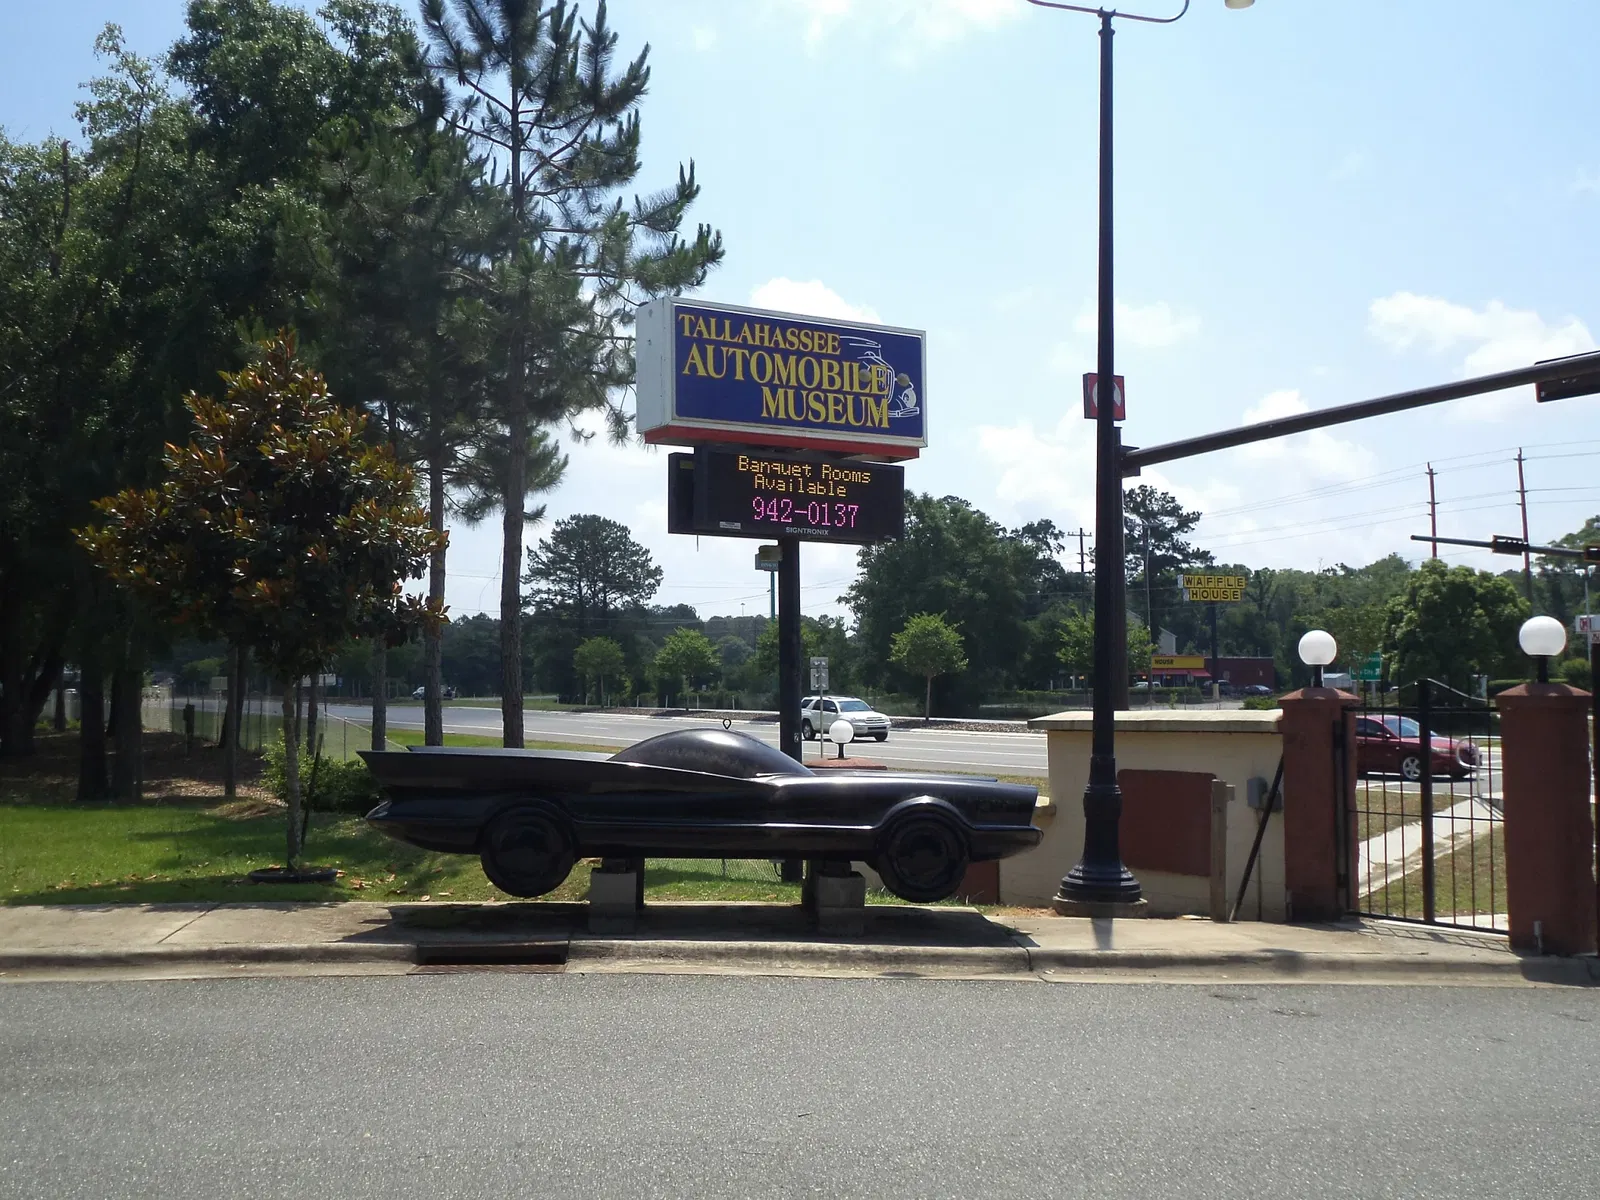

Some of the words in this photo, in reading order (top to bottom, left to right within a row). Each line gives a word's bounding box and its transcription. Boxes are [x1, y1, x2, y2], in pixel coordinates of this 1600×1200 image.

[679, 314, 841, 355] TALLAHASSEE
[683, 343, 890, 395] AUTOMOBILE
[761, 387, 890, 428] MUSEUM
[738, 455, 811, 477] Banquet
[822, 464, 871, 483] Rooms
[754, 474, 847, 497] Available
[752, 496, 859, 528] 942-0137
[785, 526, 829, 536] SIGNTRONIX
[1185, 576, 1244, 587] WAFFLE
[1191, 590, 1239, 599] HOUSE
